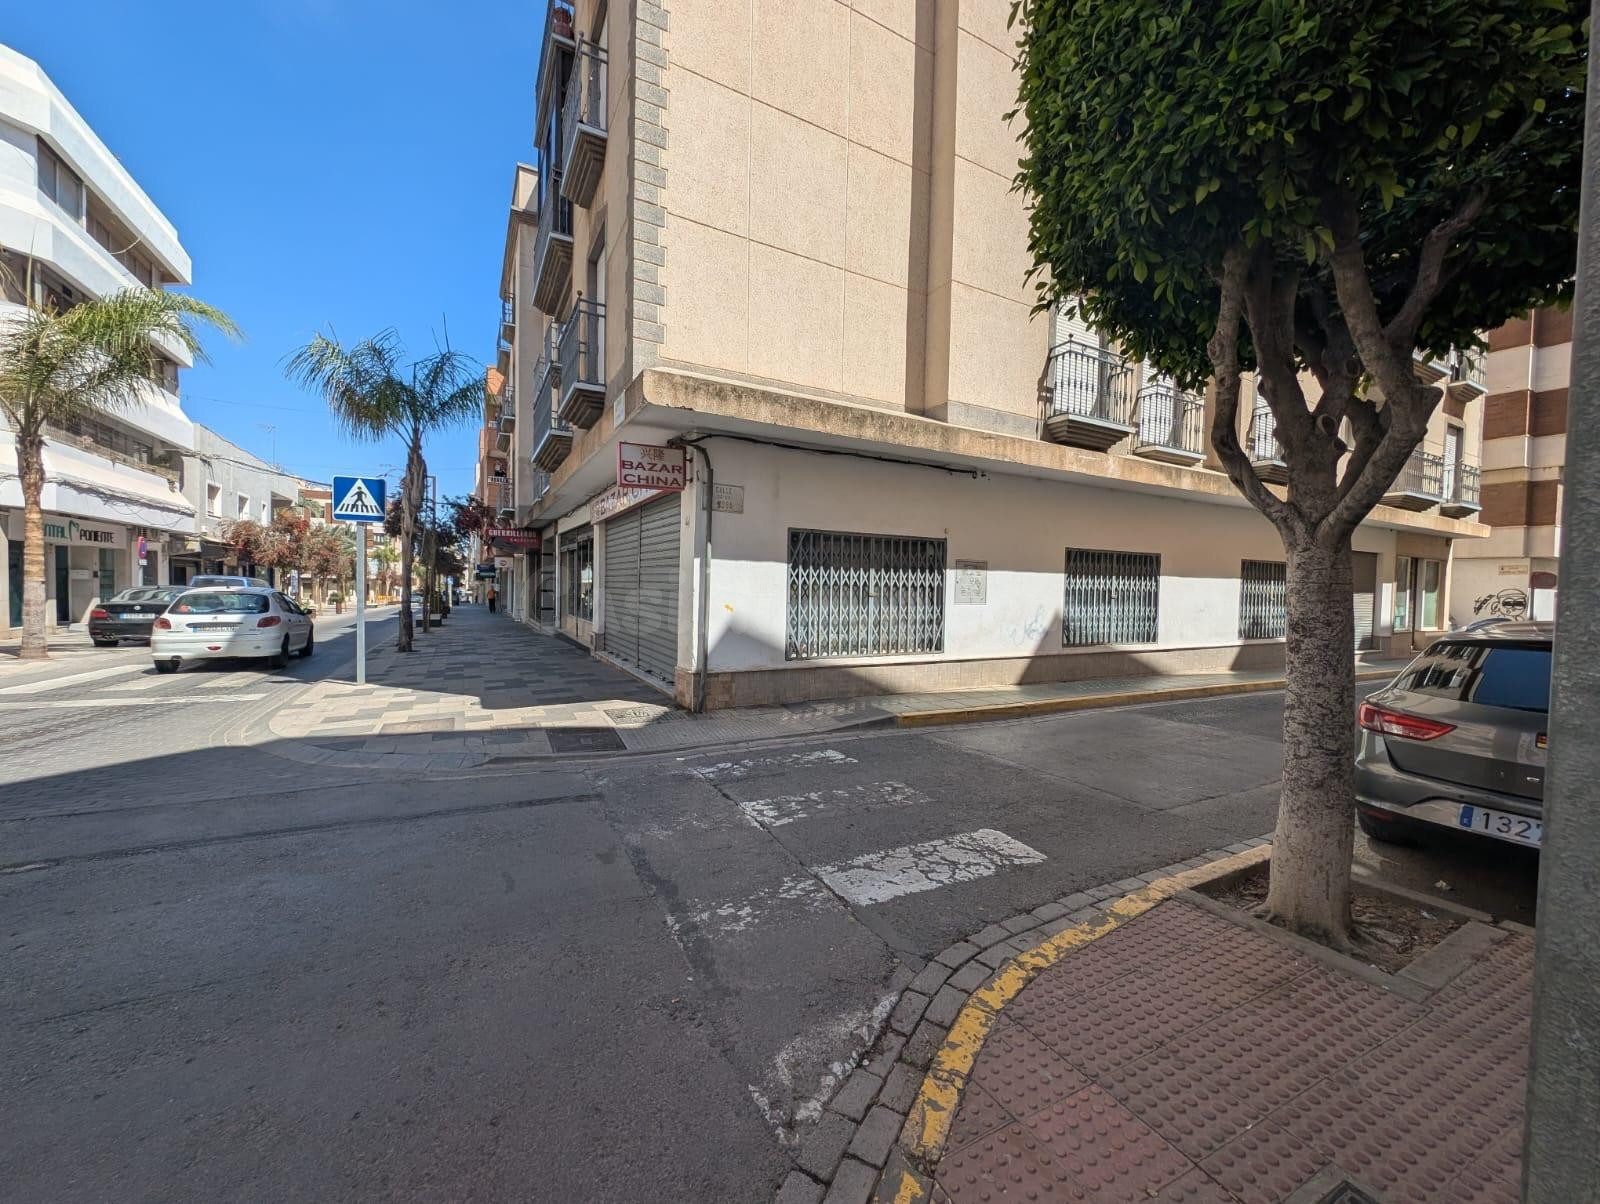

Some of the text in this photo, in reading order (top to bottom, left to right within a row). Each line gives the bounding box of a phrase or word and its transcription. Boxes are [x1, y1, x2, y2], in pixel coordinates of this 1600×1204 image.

[621, 460, 682, 474] BAZAR
[623, 474, 680, 487] CHINA
[44, 523, 115, 543] NTAL PONIENTE
